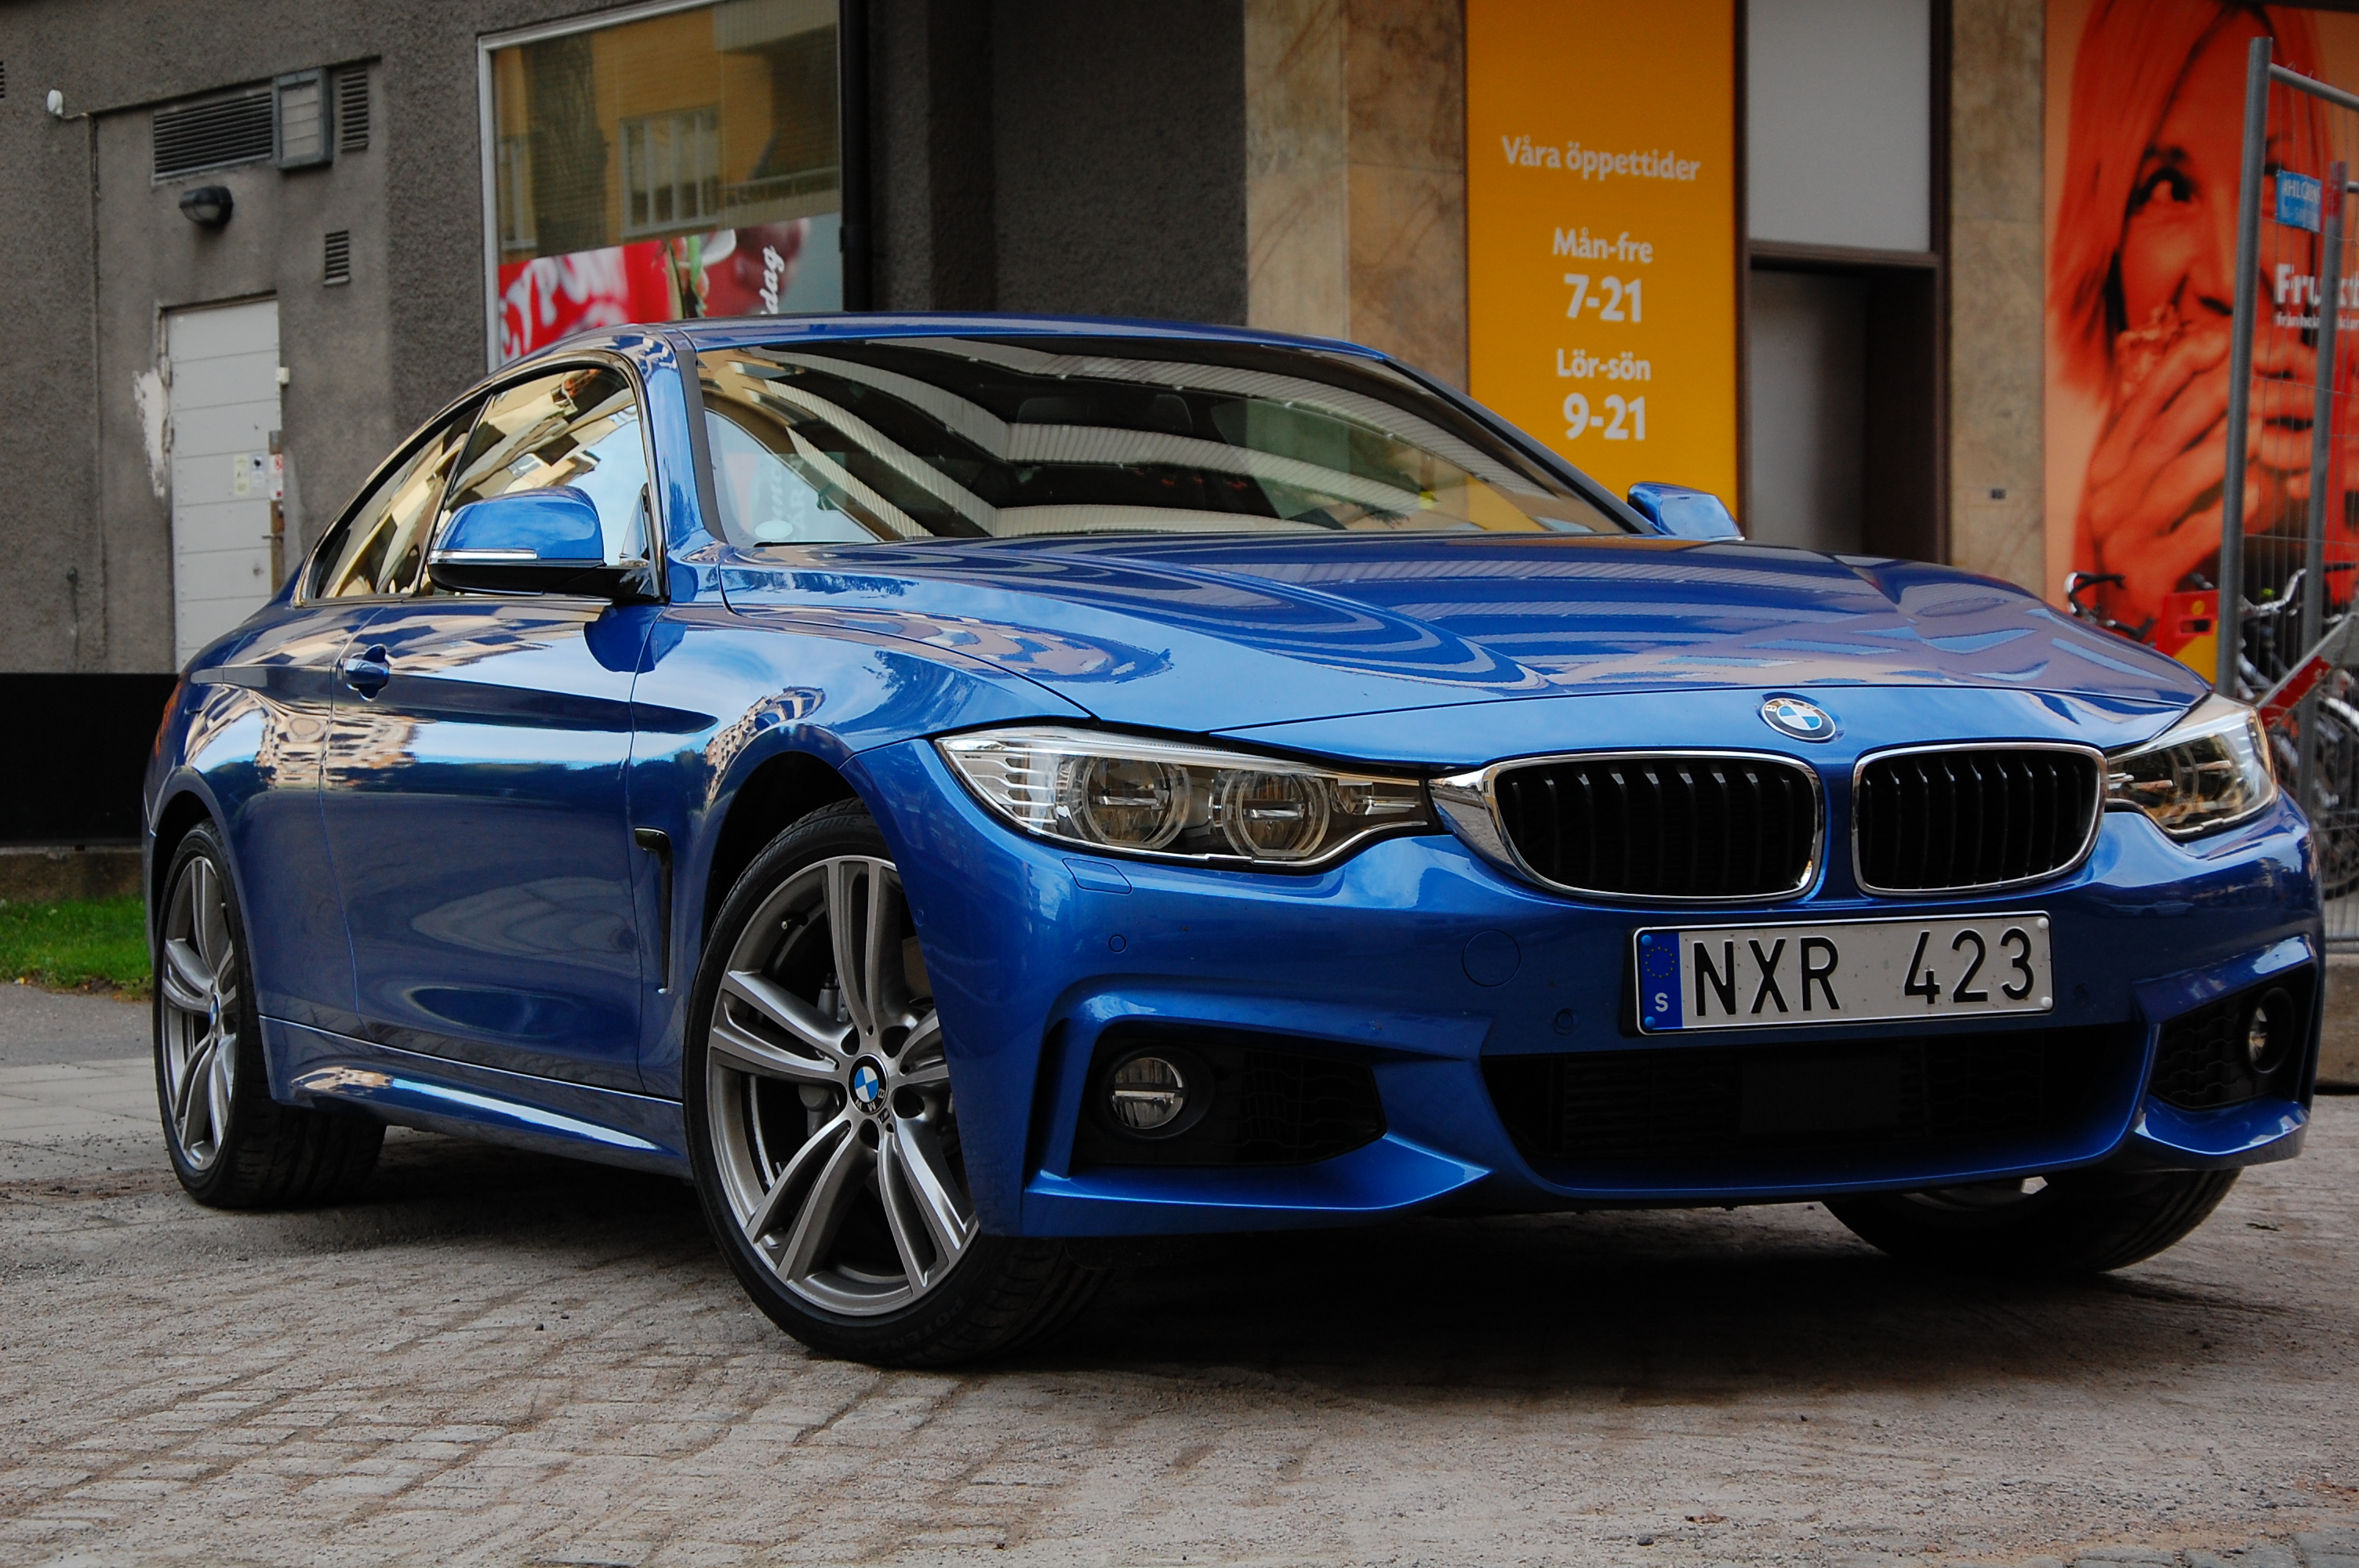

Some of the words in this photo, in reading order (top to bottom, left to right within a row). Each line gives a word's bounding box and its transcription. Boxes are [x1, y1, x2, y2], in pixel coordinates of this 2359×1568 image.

[1502, 134, 1561, 169] Våra
[1566, 141, 1701, 181] öppettider
[1553, 227, 1653, 264] Mån-fre
[758, 245, 785, 315] dag
[1564, 273, 1642, 323] 7-21
[1557, 347, 1652, 381] Lör-sön
[1563, 392, 1646, 441] 9-21
[1693, 935, 1841, 1017] NXR
[1903, 927, 2035, 1005] 423
[1656, 993, 1668, 1013] S
